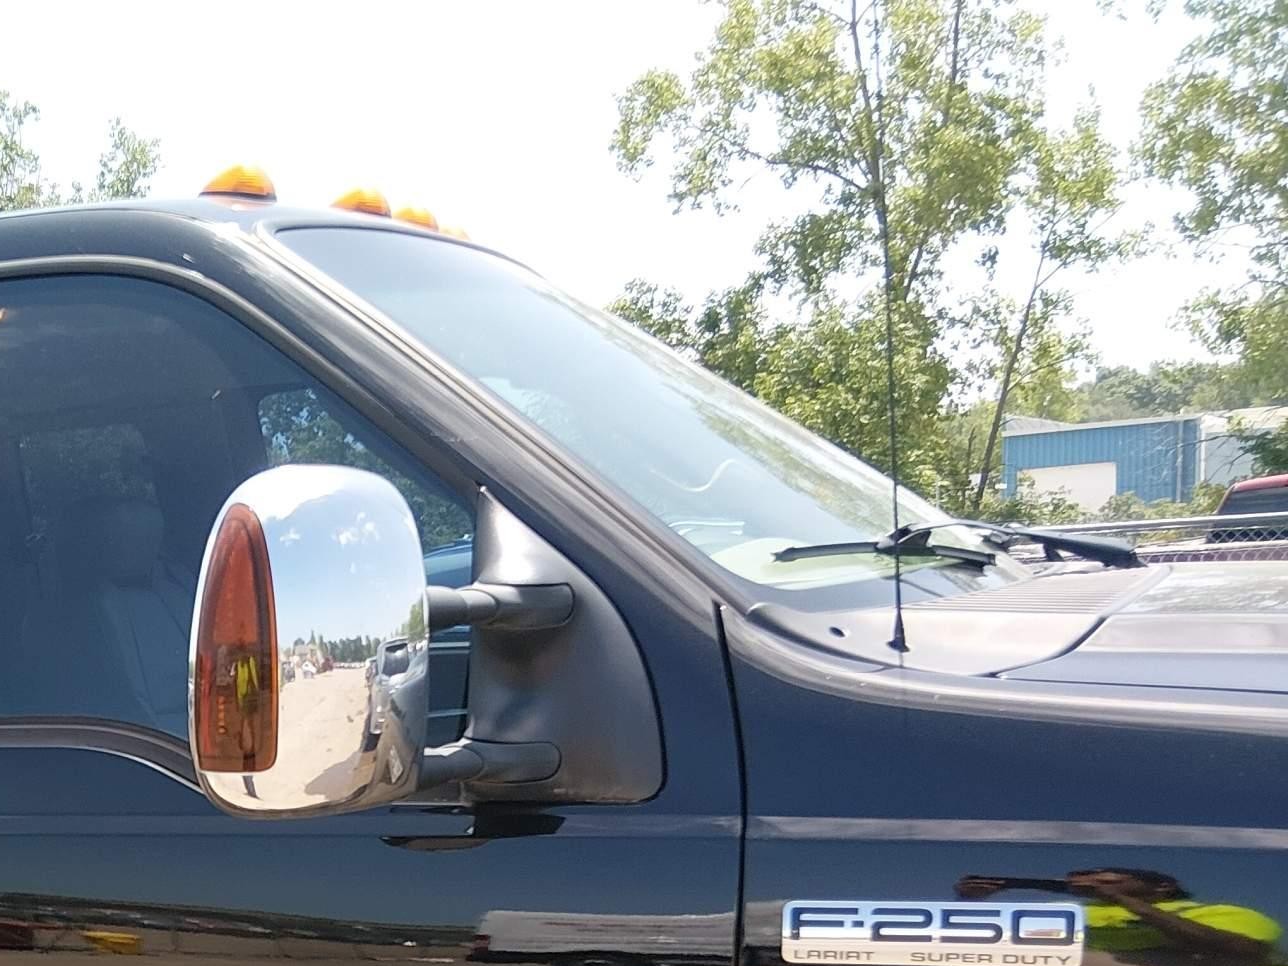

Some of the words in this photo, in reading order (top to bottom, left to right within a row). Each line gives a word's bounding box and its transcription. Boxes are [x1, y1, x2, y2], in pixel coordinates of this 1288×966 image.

[791, 907, 1076, 946] F-250
[794, 950, 876, 962] LARIAT
[910, 951, 993, 964] SUPER
[1001, 953, 1073, 966] DUTY
